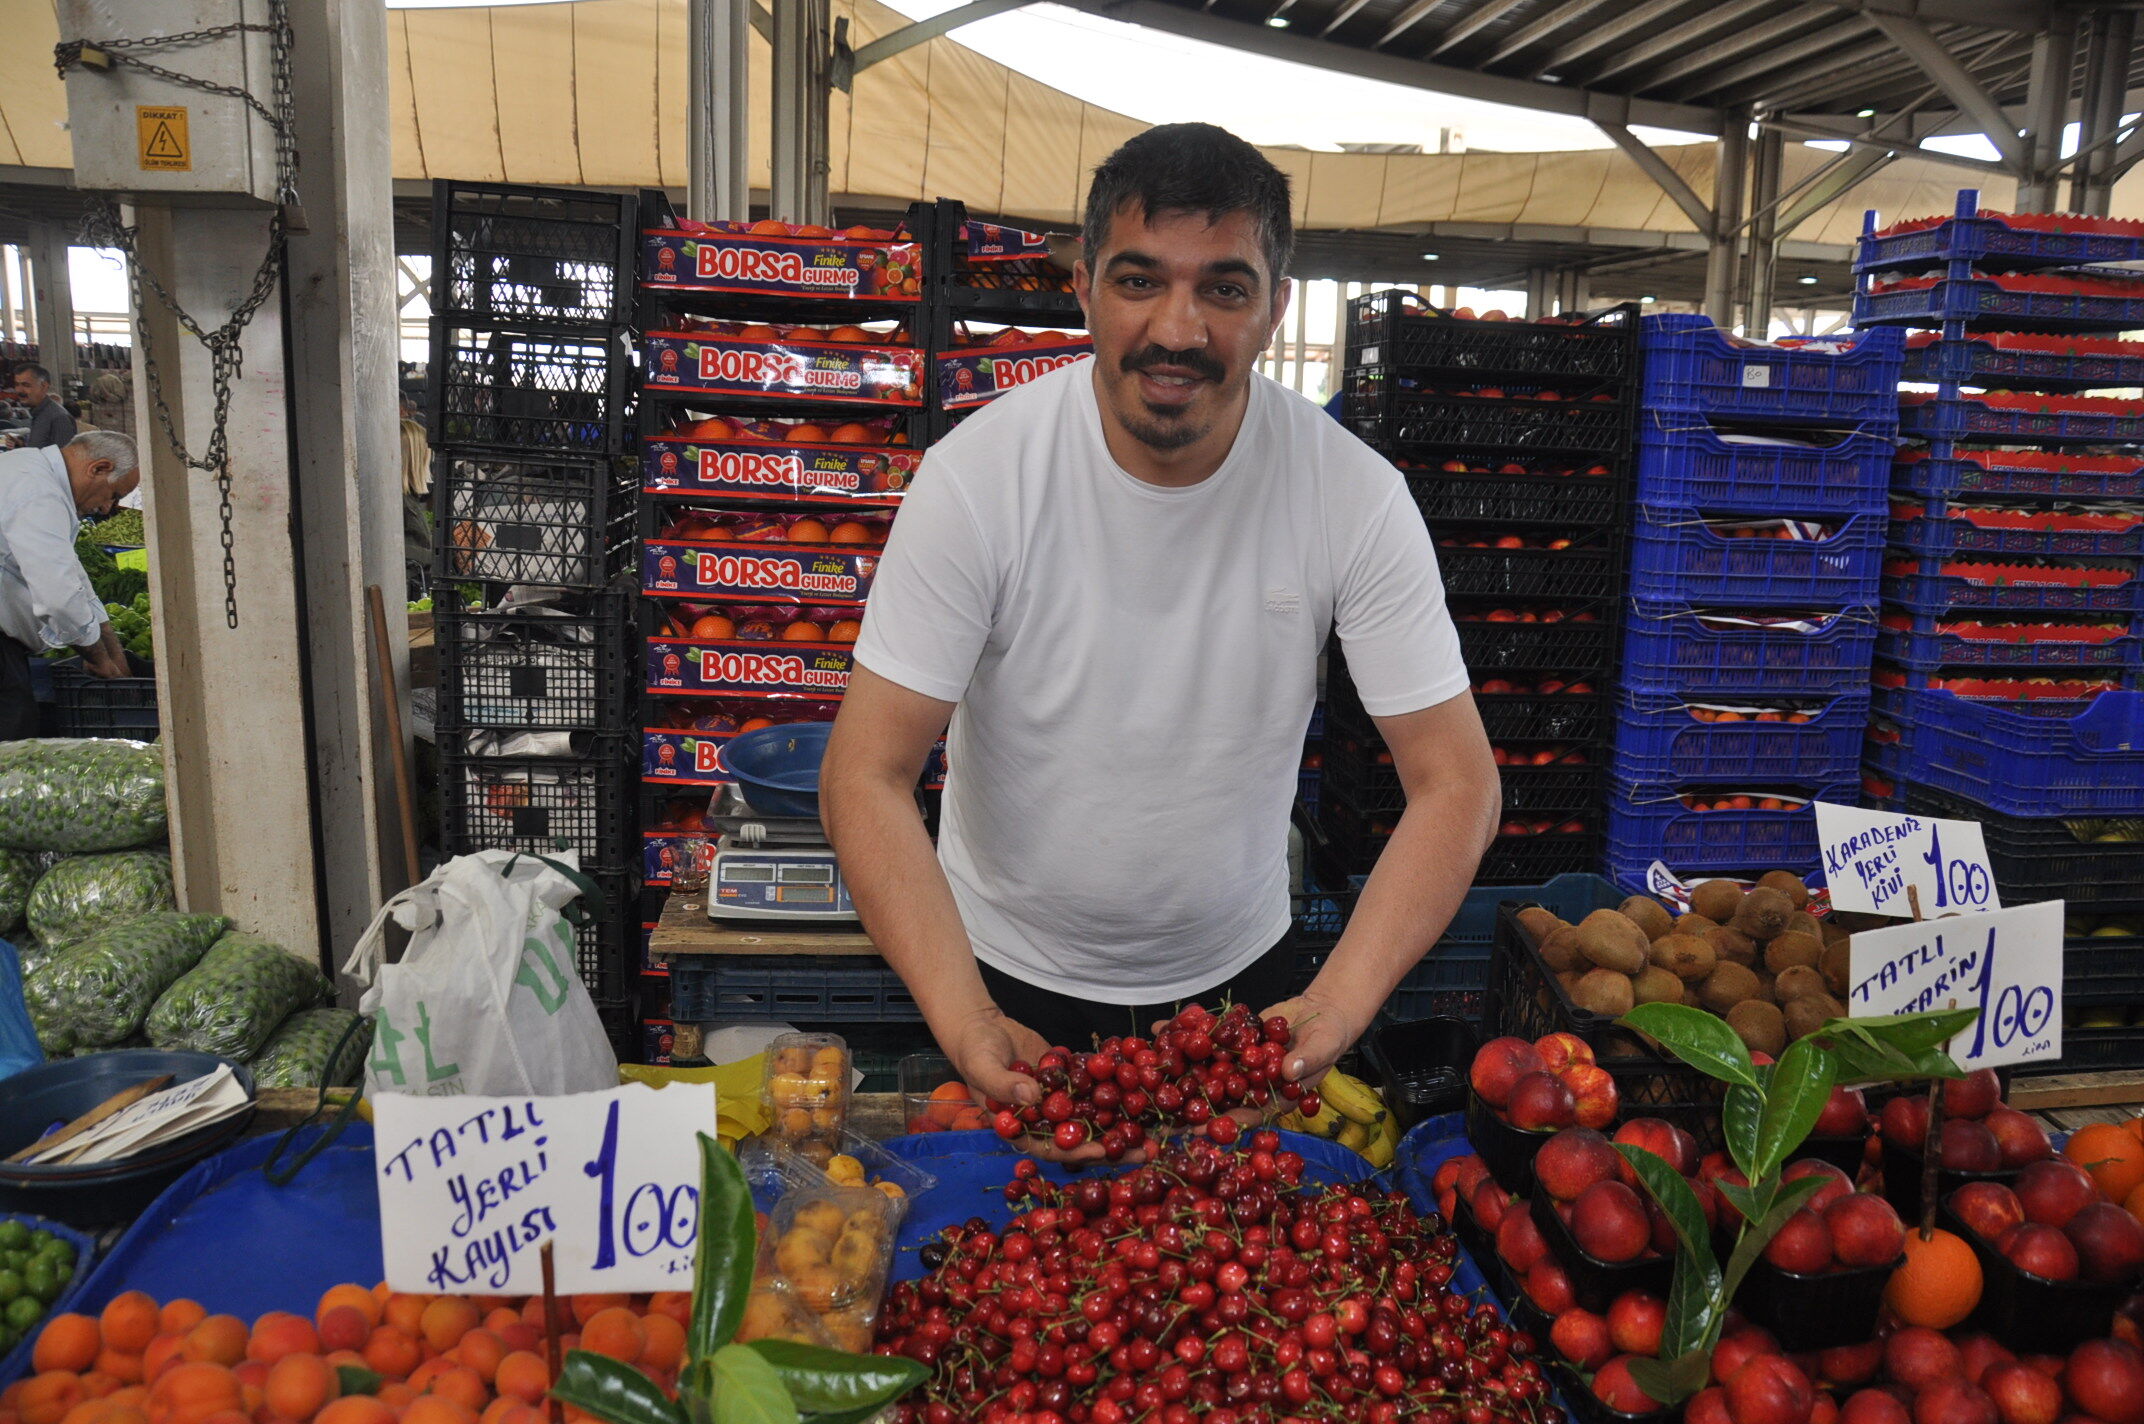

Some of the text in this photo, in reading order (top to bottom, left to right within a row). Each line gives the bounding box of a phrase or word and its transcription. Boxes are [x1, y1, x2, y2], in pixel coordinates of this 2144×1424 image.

[992, 352, 1095, 391] BOR
[804, 670, 851, 688] GURM
[1923, 823, 1989, 907] 100
[1851, 934, 1944, 1003] TATLI
[1966, 927, 2053, 1059] 100
[384, 1101, 543, 1182] TATLI
[584, 1100, 700, 1271] 100
